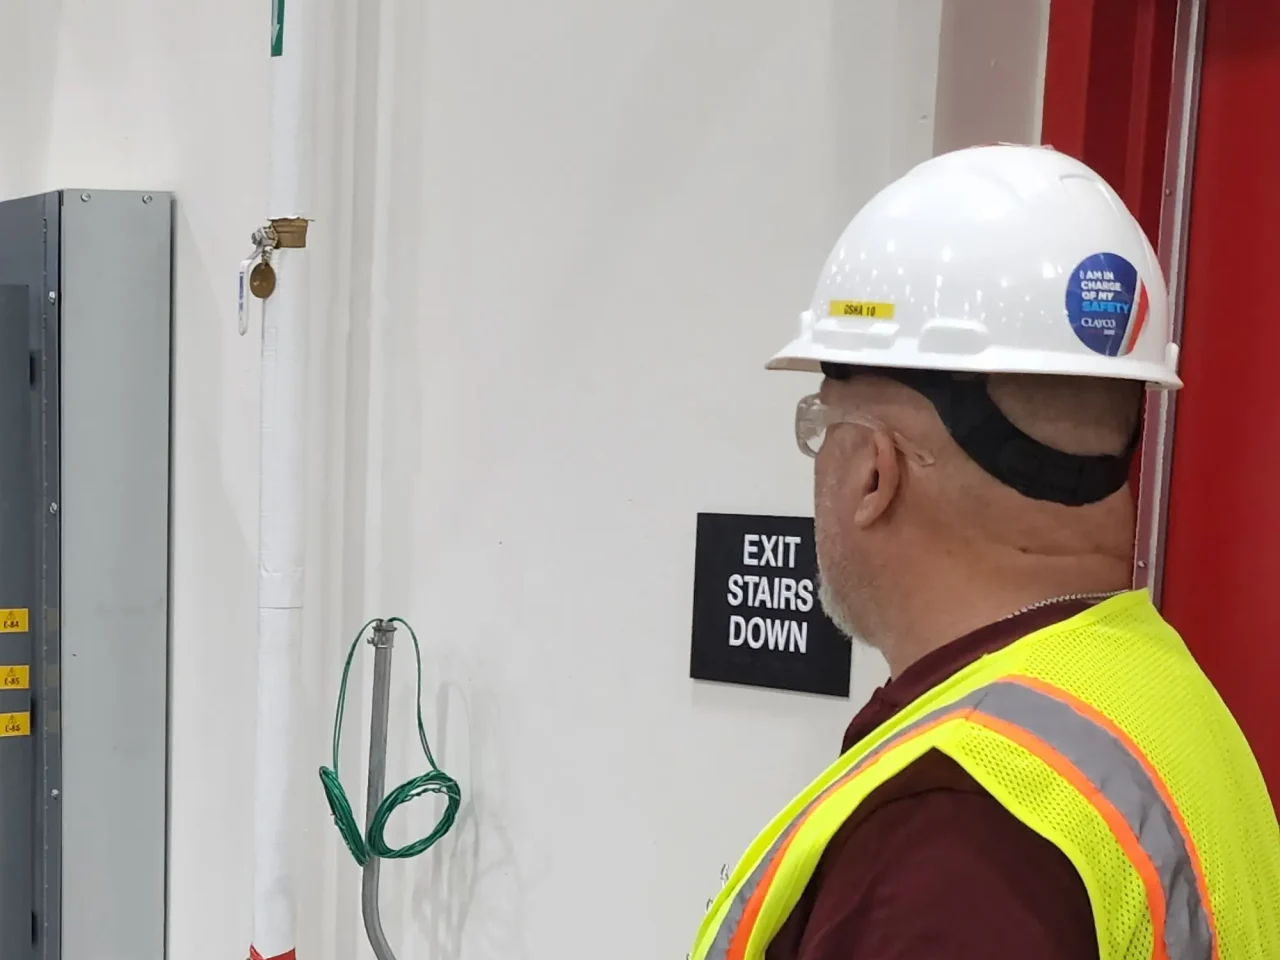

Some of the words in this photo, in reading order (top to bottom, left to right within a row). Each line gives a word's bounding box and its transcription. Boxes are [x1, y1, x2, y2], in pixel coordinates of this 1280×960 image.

[1086, 270, 1102, 280] AM
[1104, 271, 1114, 280] IN
[1081, 281, 1122, 291] CHARGE
[1082, 291, 1097, 300] OF
[1098, 291, 1115, 301] MY
[844, 304, 863, 316] OSHA
[866, 305, 876, 317] 10
[1082, 301, 1130, 314] SAFETY
[1081, 317, 1116, 328] CLAYCO
[742, 533, 802, 569] EXIT
[726, 573, 814, 613] STAIRS
[728, 615, 808, 654] DOWN
